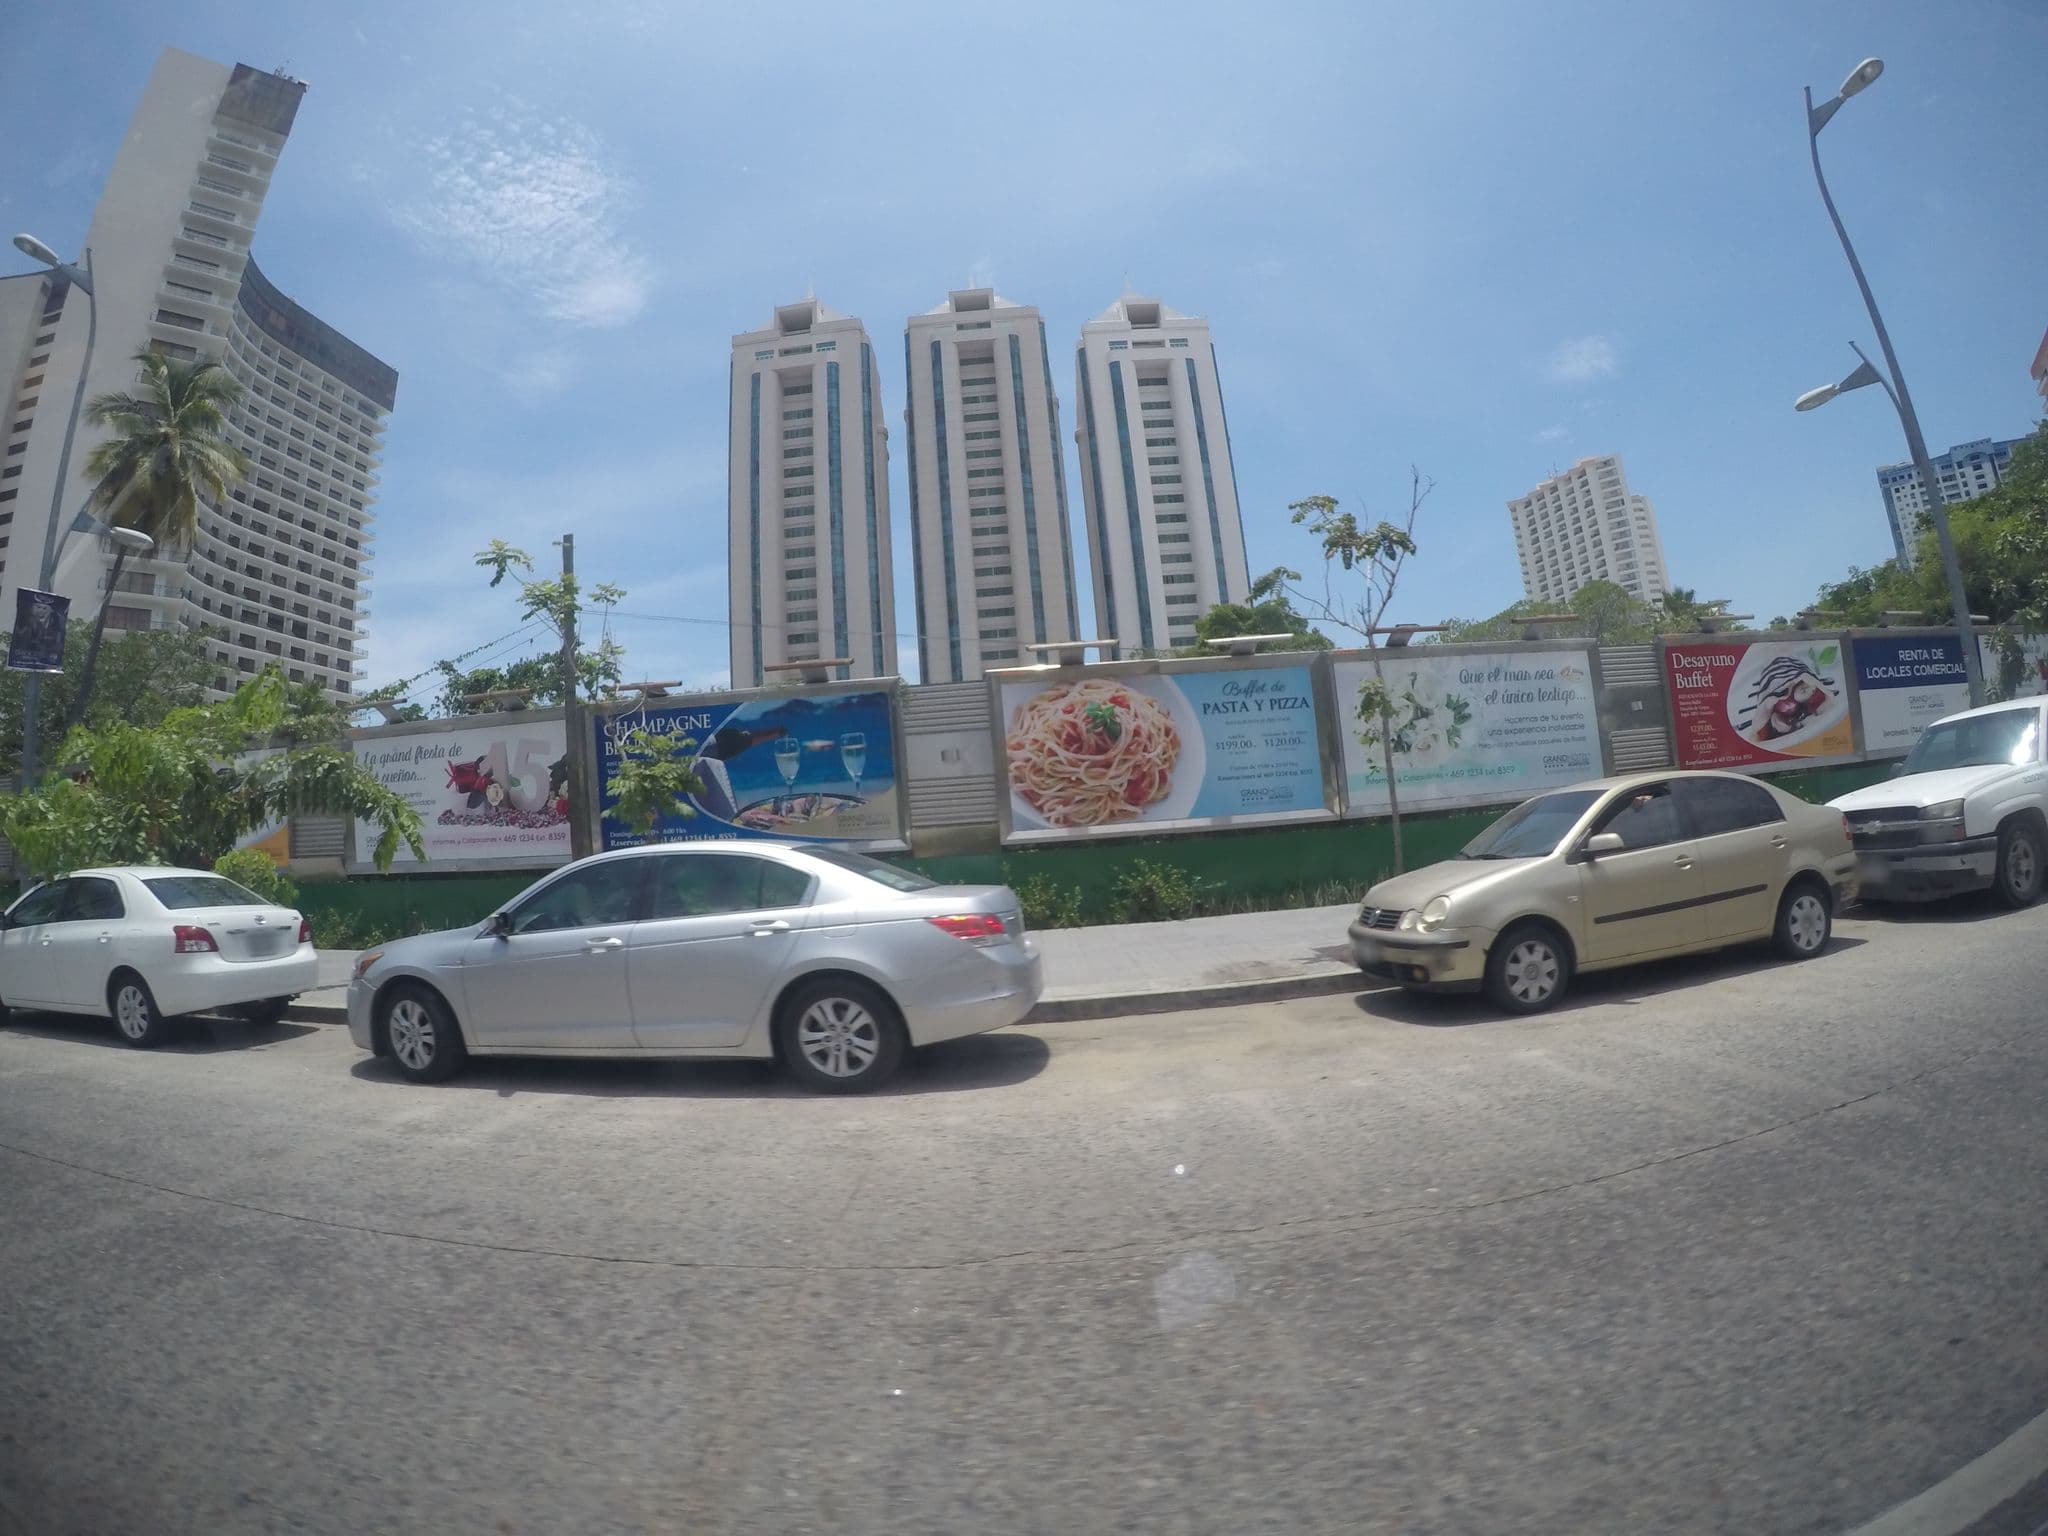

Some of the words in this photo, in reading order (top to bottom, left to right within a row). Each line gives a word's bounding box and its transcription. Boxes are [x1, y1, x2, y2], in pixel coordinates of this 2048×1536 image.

[1672, 653, 1736, 671] Desayuno
[1898, 649, 1930, 661] RENTA
[1931, 648, 1945, 660] DE
[1460, 669, 1484, 684] Que
[1487, 667, 1500, 682] el
[1504, 670, 1531, 681] mar
[1535, 669, 1554, 680] sea
[1866, 665, 1912, 679] LOCALES
[1913, 663, 1966, 676] COMERCIAL
[1675, 671, 1714, 689] Buffet
[1222, 680, 1266, 698] Buffet
[1271, 680, 1286, 692] de
[1485, 689, 1498, 704] el
[1502, 689, 1534, 704] único
[1202, 701, 1250, 715] PASTA
[1254, 699, 1264, 711] Y
[1270, 697, 1310, 711] PIZZA
[603, 713, 712, 737] CHAMPAGNE
[448, 742, 463, 757] de
